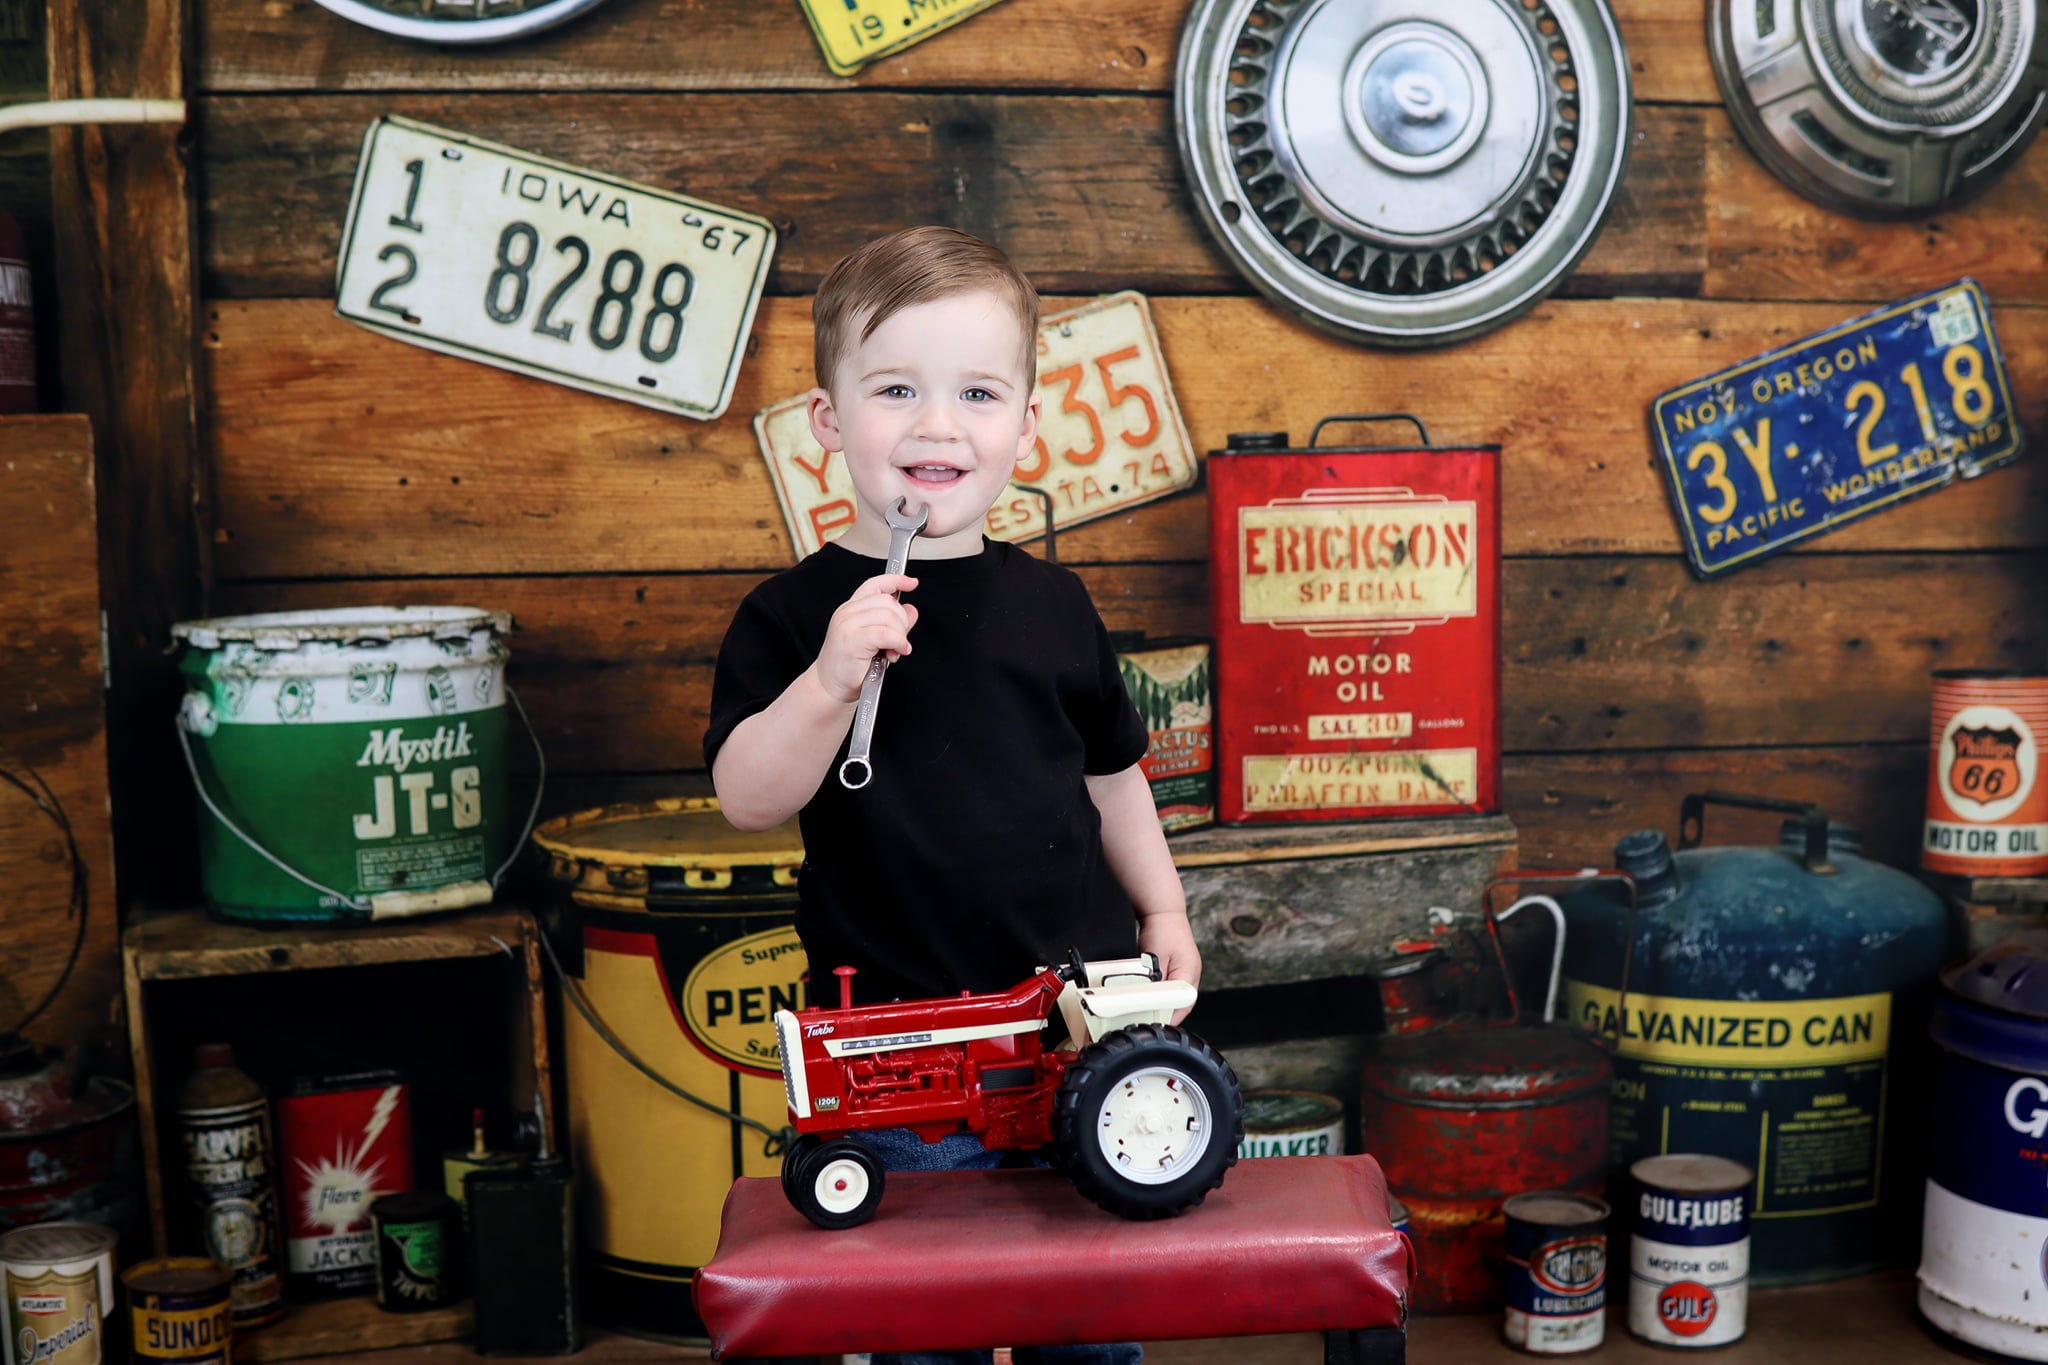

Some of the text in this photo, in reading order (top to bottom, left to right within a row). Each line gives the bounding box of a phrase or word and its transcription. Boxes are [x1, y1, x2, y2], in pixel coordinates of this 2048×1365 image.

[850, 15, 884, 47] 19
[502, 167, 630, 228] IOWA
[702, 226, 751, 257] 67
[485, 221, 695, 364] 8288
[1752, 340, 1878, 403] OREGON
[986, 453, 1171, 533] ESOTA 74
[1706, 421, 2002, 551] PACIFIC WONDERLAND
[1246, 523, 1467, 575] ERICKSON
[1299, 581, 1423, 604] SPECIAL
[1308, 653, 1412, 676] MOTOR
[1336, 681, 1384, 702] OIL
[1418, 717, 1465, 730] GALLONS
[356, 721, 473, 773] Mystik
[1150, 730, 1209, 753] ACTUS
[1962, 764, 2006, 794] 66
[352, 765, 481, 840] JT-6
[1928, 826, 2040, 852] MOTOR OIL
[742, 942, 804, 965] Supre
[706, 980, 810, 1028] PEN
[804, 1024, 835, 1038] Turbo
[1583, 1001, 1873, 1049] GALVANIZED CAN
[745, 1039, 780, 1059] Saf
[843, 1034, 931, 1050] FARMALL
[1640, 1193, 1743, 1228] GULFLUBE
[309, 1248, 362, 1270] JACK
[1647, 1256, 1729, 1273] MOTOR OIL
[21, 1298, 62, 1310] ATLANTIC
[1663, 1295, 1714, 1322] GULF
[20, 1302, 95, 1365] Imperial
